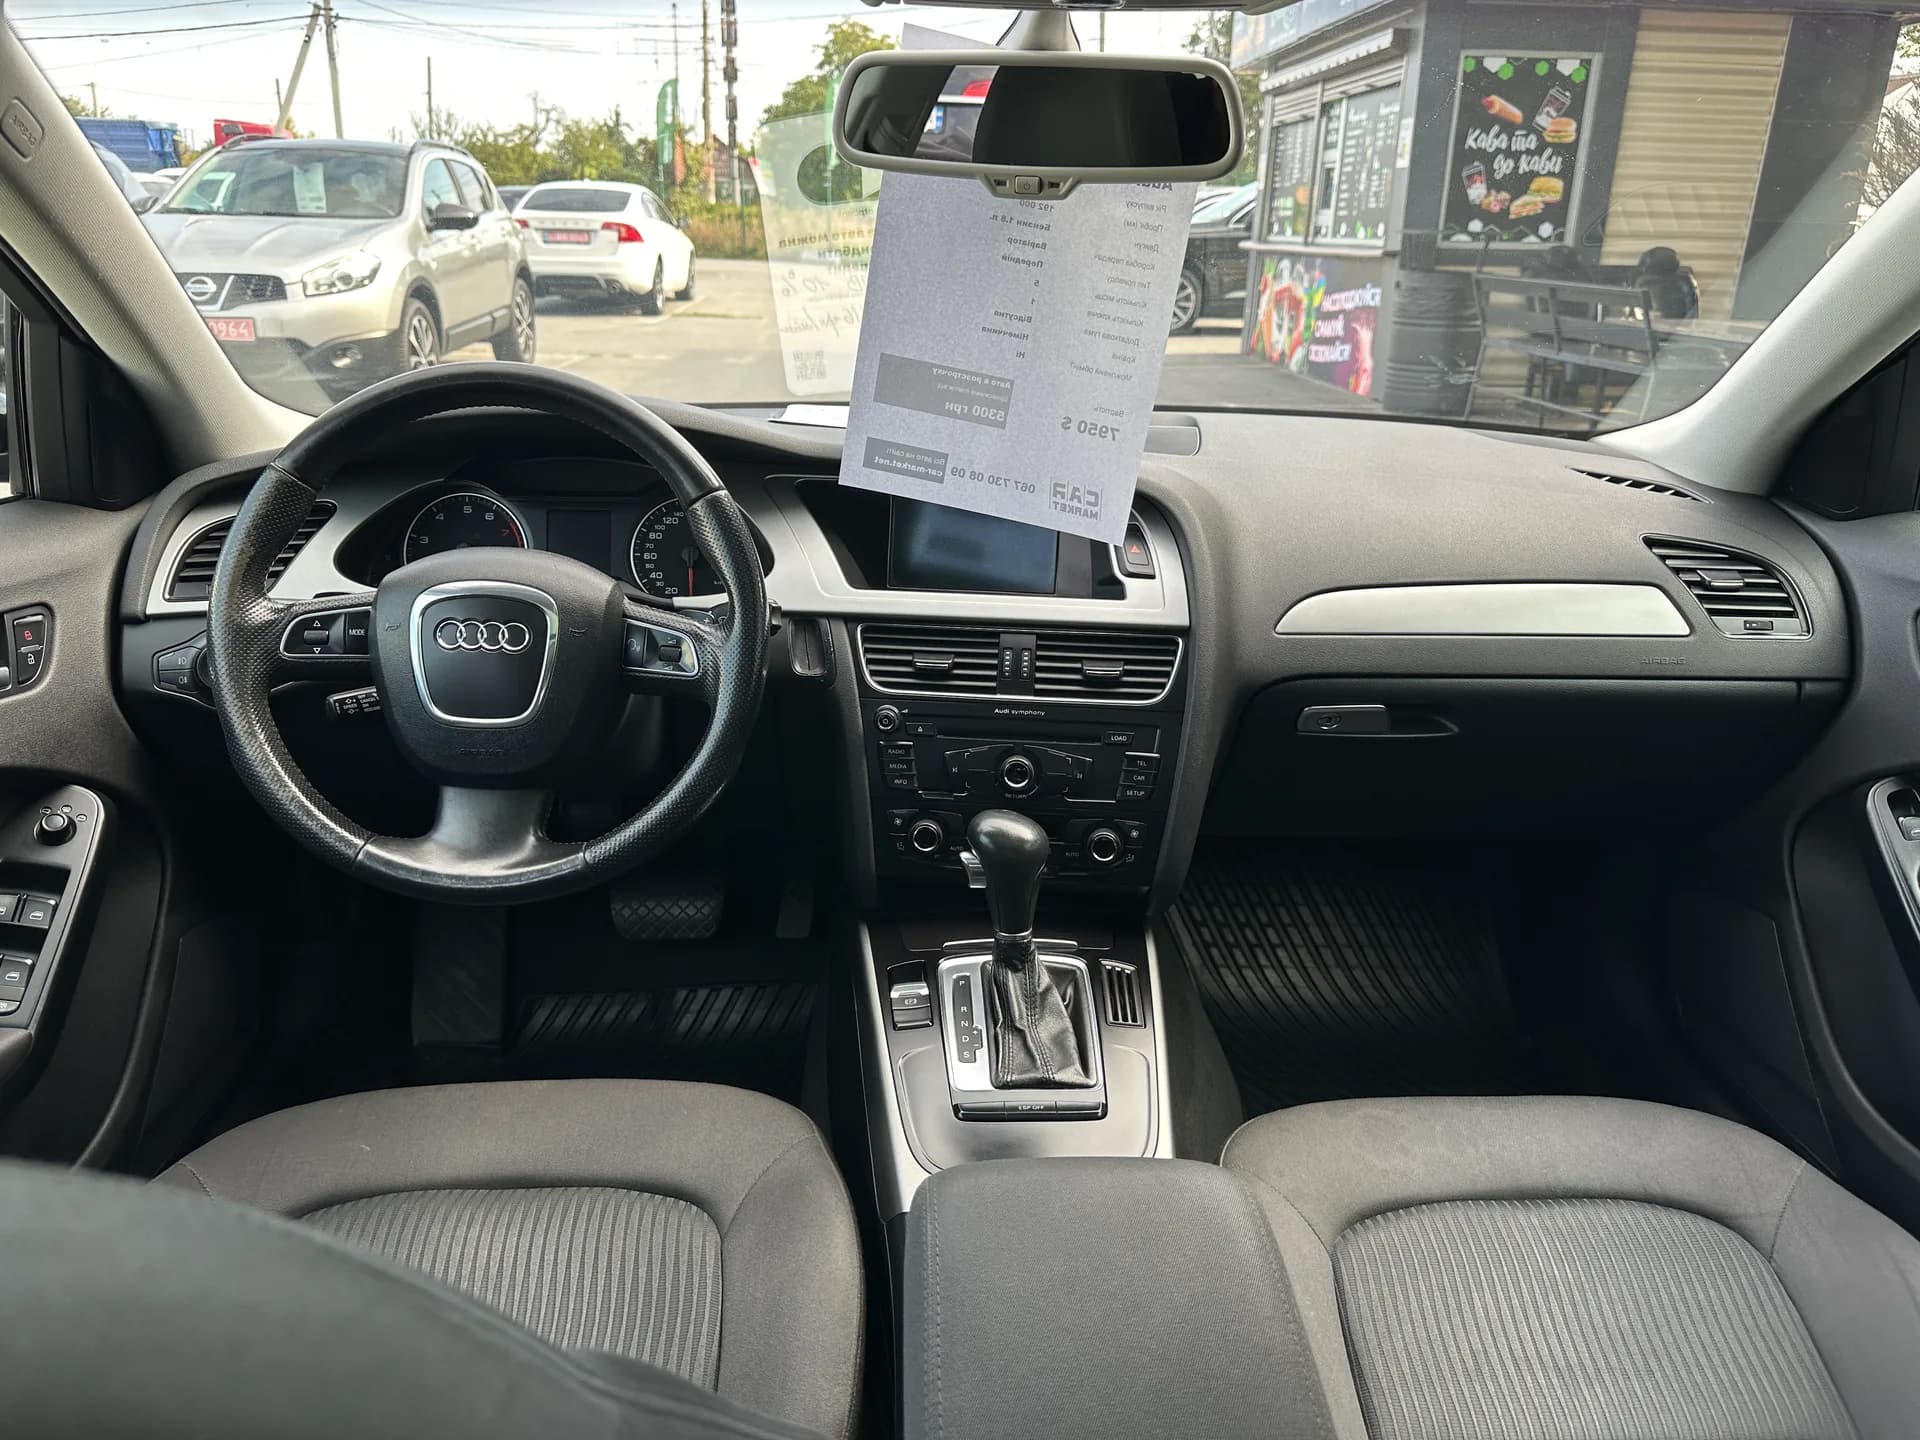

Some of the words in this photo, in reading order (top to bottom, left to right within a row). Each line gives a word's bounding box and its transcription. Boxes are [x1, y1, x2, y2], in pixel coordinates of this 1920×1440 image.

[1464, 124, 1509, 153] Кава
[1510, 129, 1538, 152] та
[1493, 153, 1515, 180] до
[464, 505, 473, 513] 5
[435, 512, 444, 520] 4
[485, 512, 494, 520] 6
[662, 517, 679, 525] 120
[501, 528, 510, 536] 7
[649, 532, 663, 540] 80
[419, 536, 429, 544] 3
[643, 552, 657, 560] 60
[649, 571, 663, 579] 40
[665, 587, 678, 595] 20
[349, 628, 366, 636] MODE
[1639, 655, 1686, 665] AIRBAG
[1011, 708, 1046, 716] symphony
